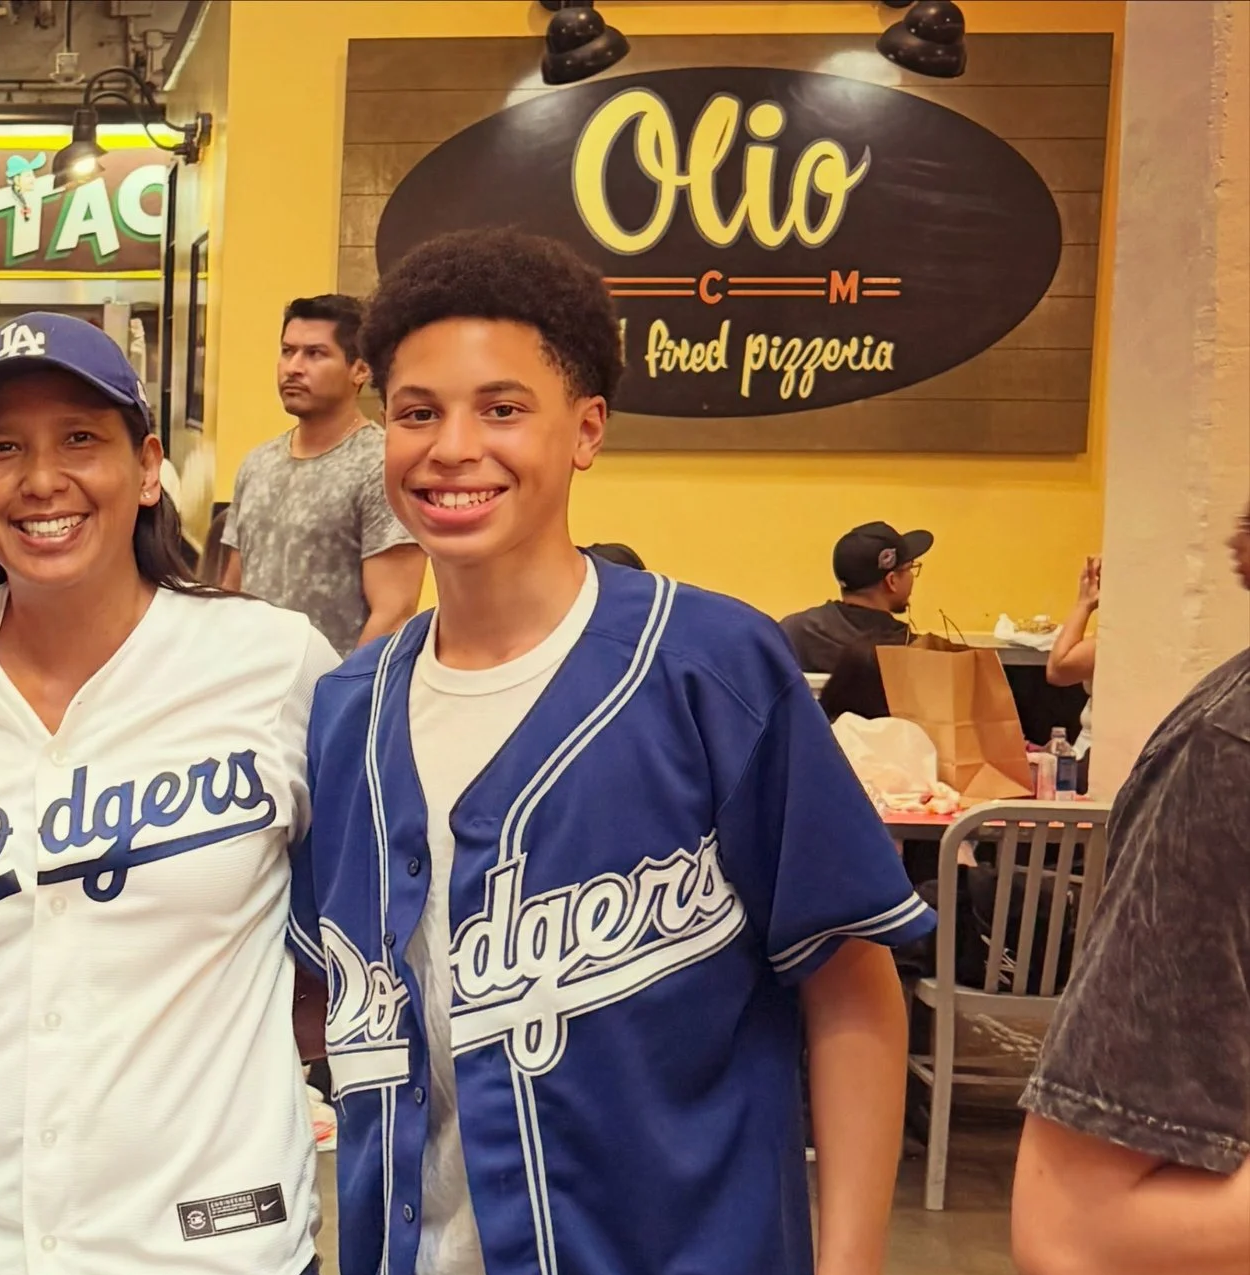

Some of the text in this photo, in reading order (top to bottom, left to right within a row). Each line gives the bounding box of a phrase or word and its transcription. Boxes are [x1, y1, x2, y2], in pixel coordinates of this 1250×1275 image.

[572, 87, 871, 255] Olio
[699, 270, 859, 304] C M
[645, 319, 730, 378] fired
[740, 333, 894, 400] pizzeria
[320, 829, 746, 1076] Dodgers
